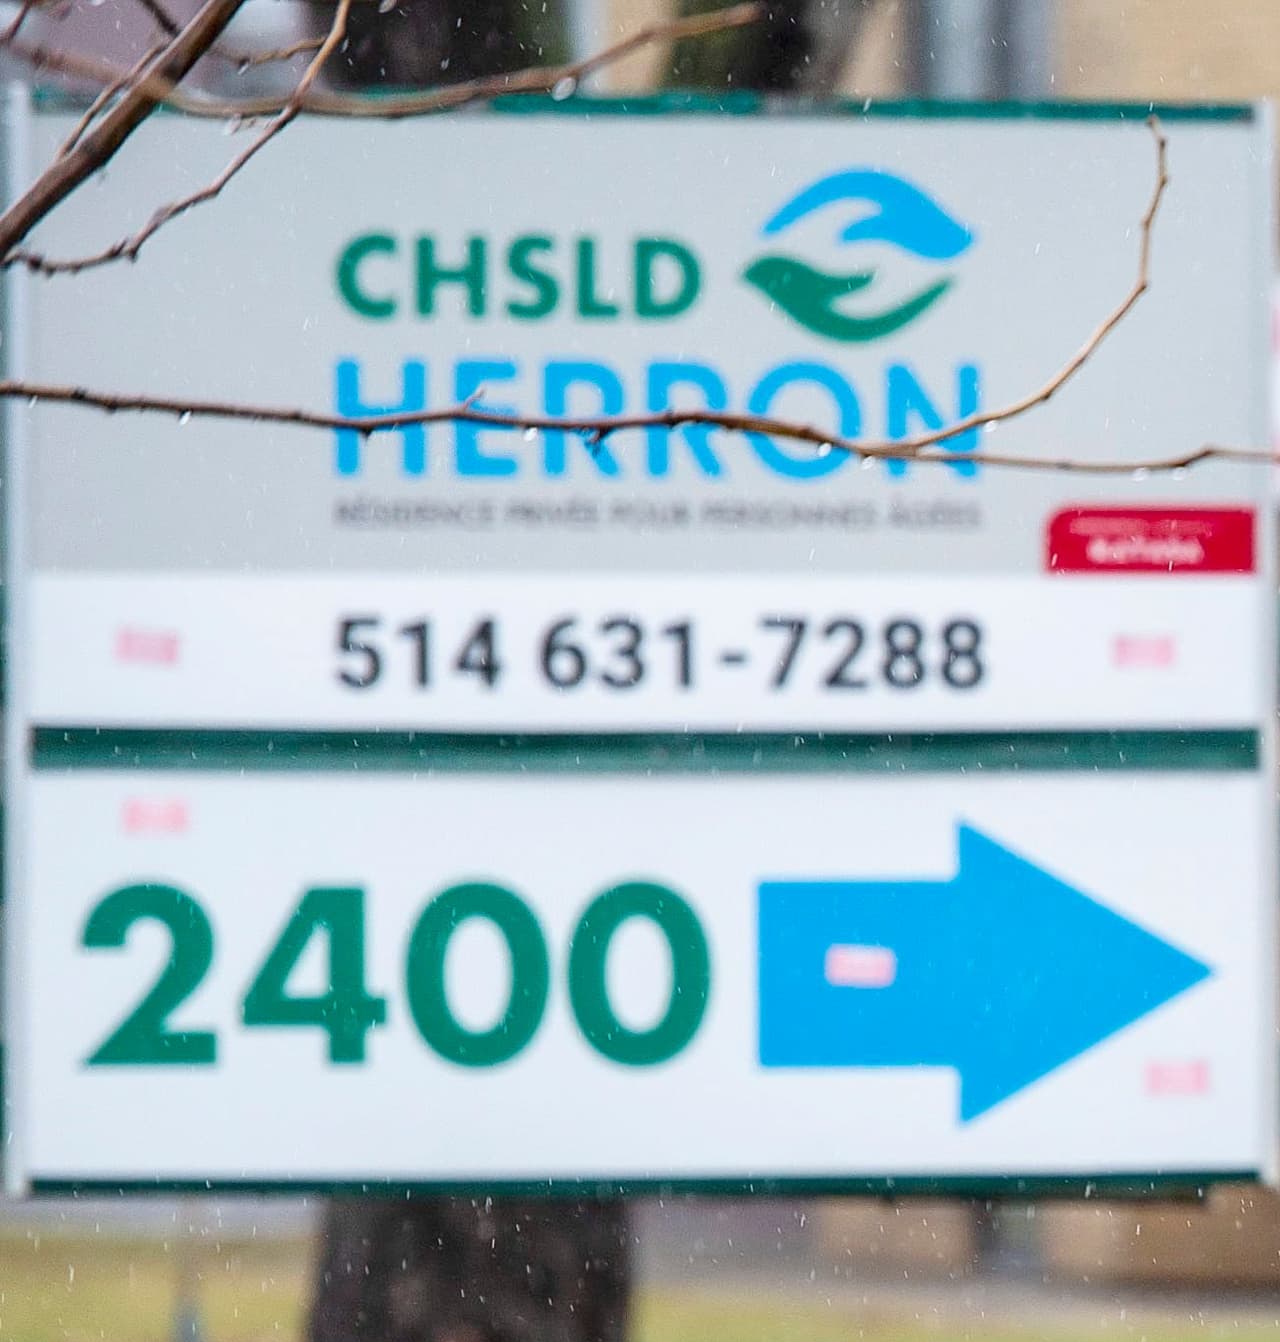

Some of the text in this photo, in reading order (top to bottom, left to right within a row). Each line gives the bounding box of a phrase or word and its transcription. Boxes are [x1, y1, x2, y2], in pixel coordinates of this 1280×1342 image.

[334, 231, 706, 323] CHSLD
[331, 355, 985, 483] HERRON
[337, 616, 986, 692] 514 631-7288
[80, 881, 714, 1069] 2400
